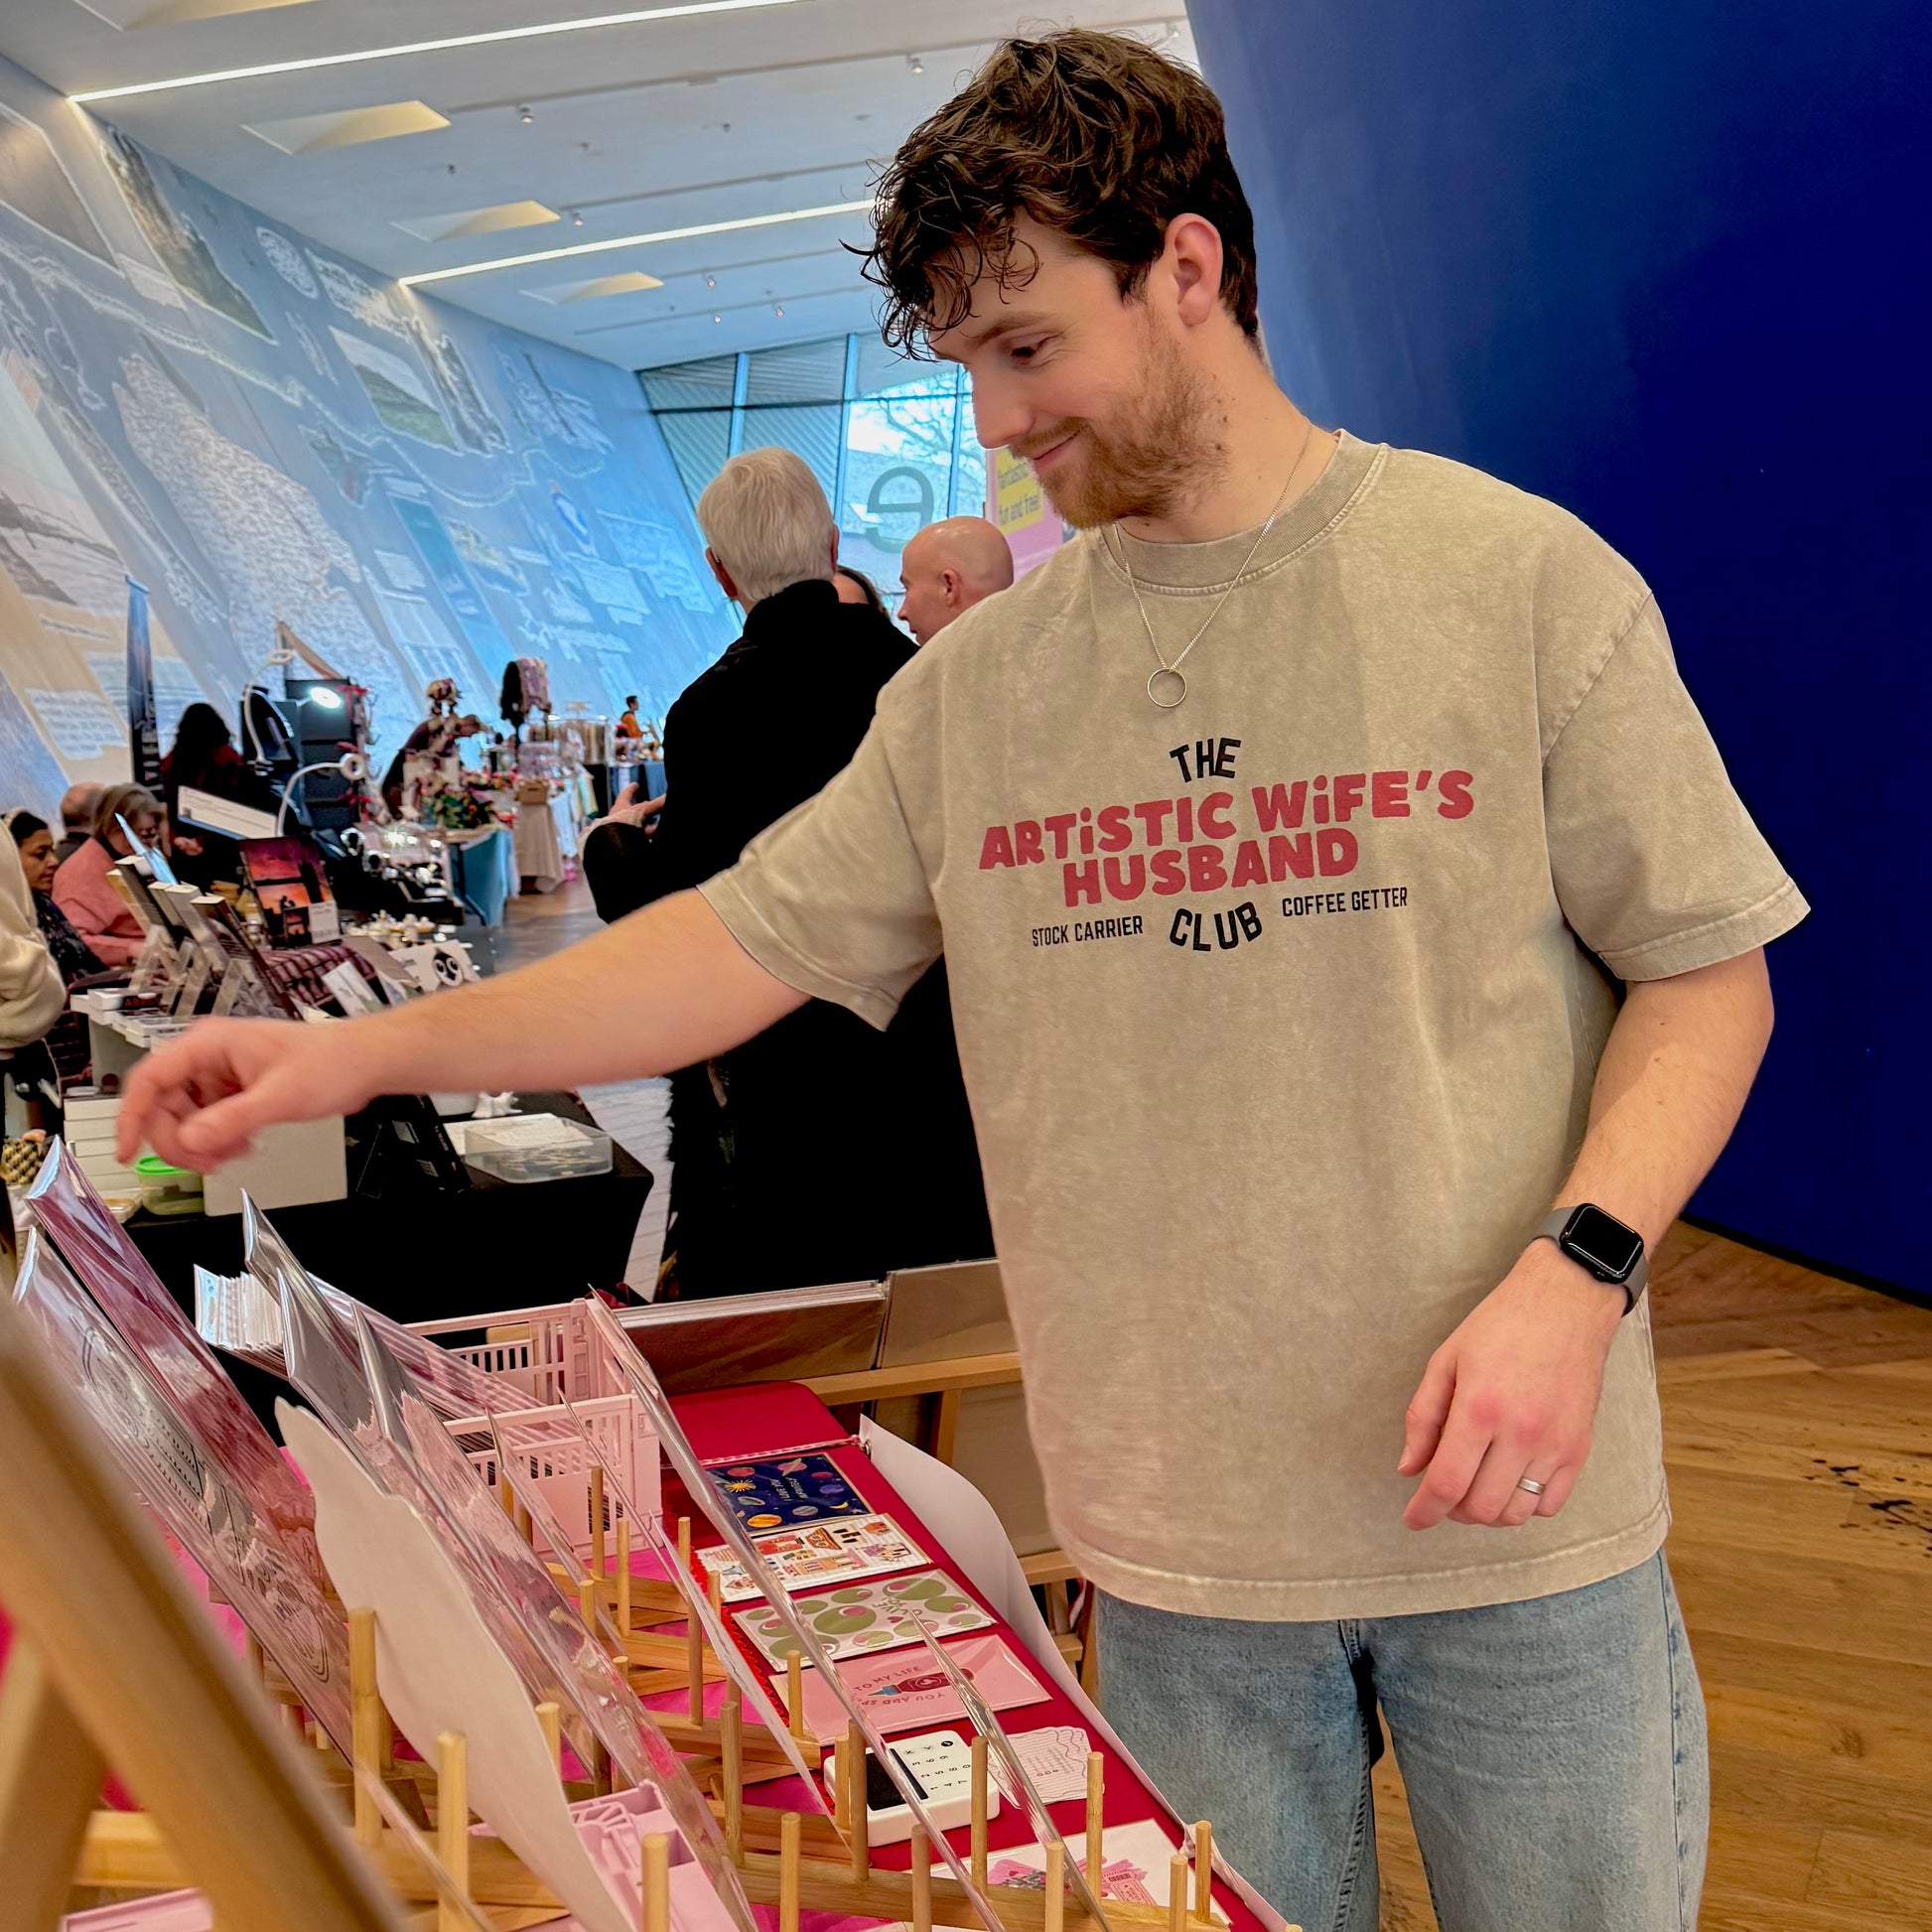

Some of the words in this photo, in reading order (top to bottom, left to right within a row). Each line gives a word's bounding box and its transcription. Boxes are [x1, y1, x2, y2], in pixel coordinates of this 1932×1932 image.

[1170, 737, 1242, 782] THE
[979, 791, 1237, 870] ARTiSTIC
[1251, 769, 1474, 832] WiFE'S
[1063, 827, 1359, 907] HUSBAND
[1281, 893, 1346, 917] COFFEE
[1351, 887, 1408, 910] GETTER
[1033, 925, 1069, 947] STOCK
[1074, 915, 1143, 942] CARRIER
[1170, 901, 1262, 952] CLUB
[854, 1683, 873, 1692] TO
[874, 1675, 892, 1684] MY
[894, 1666, 923, 1677] LIFE
[883, 1696, 910, 1705] ADD
[915, 1692, 945, 1701] YOU
